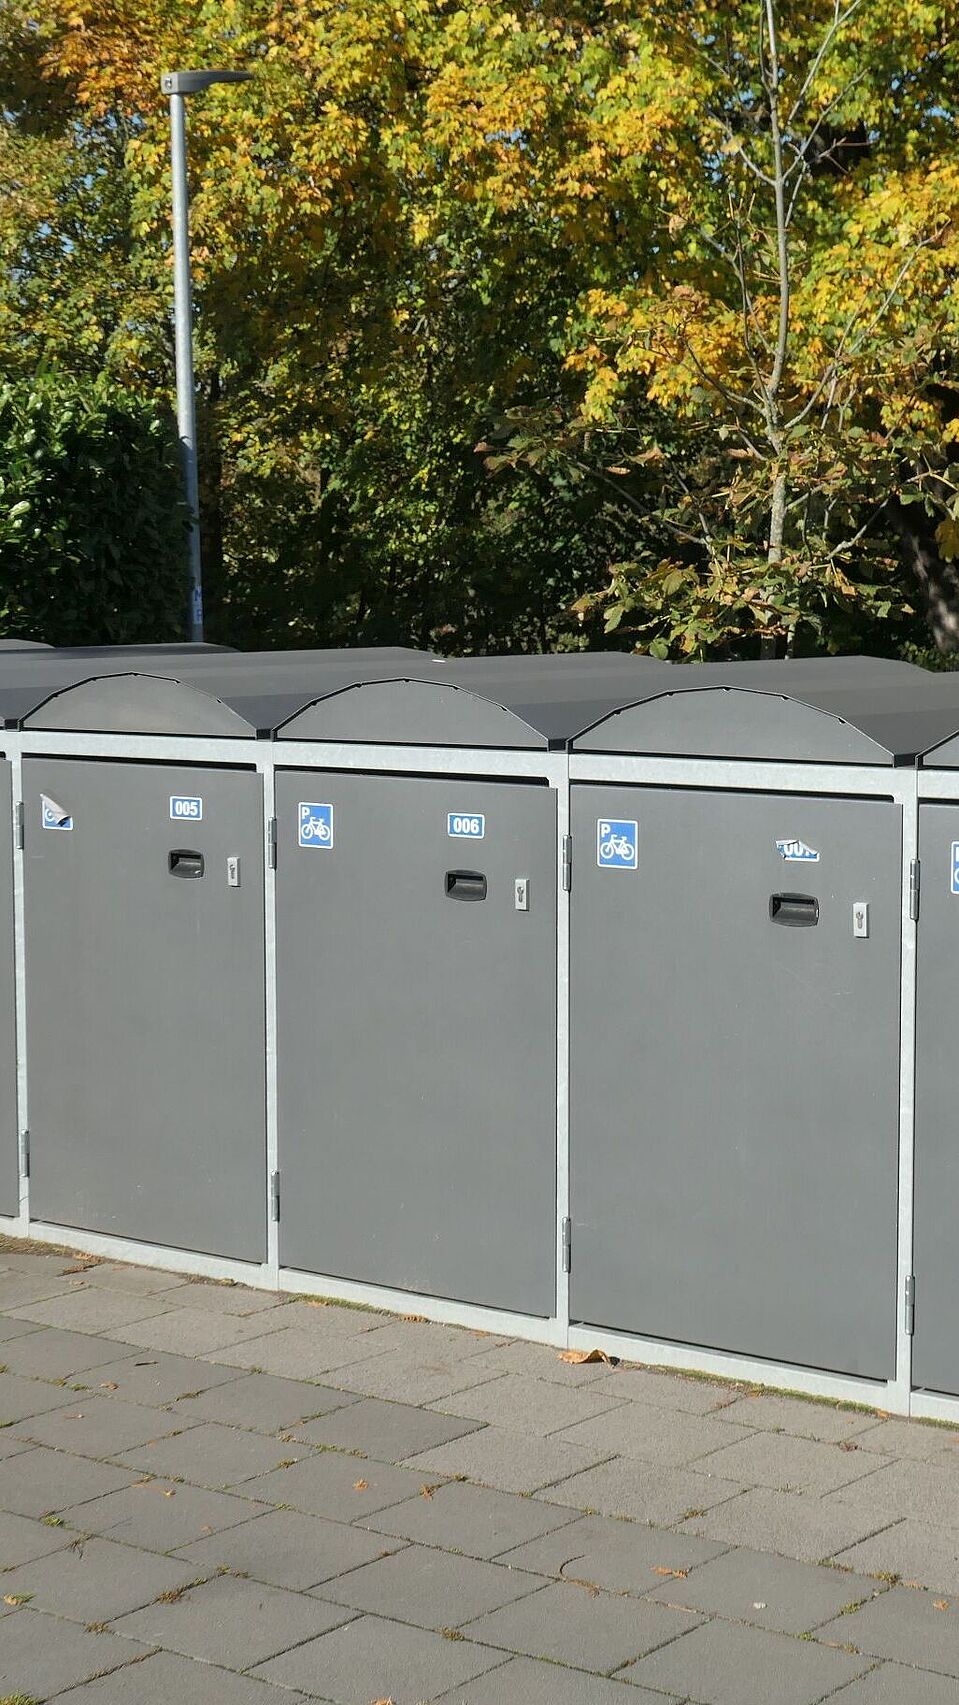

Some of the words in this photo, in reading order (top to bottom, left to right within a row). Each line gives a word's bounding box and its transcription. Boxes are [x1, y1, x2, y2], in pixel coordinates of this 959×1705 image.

[175, 801, 198, 816] 005
[301, 806, 311, 819] P
[453, 817, 480, 834] 006
[601, 823, 611, 838] P
